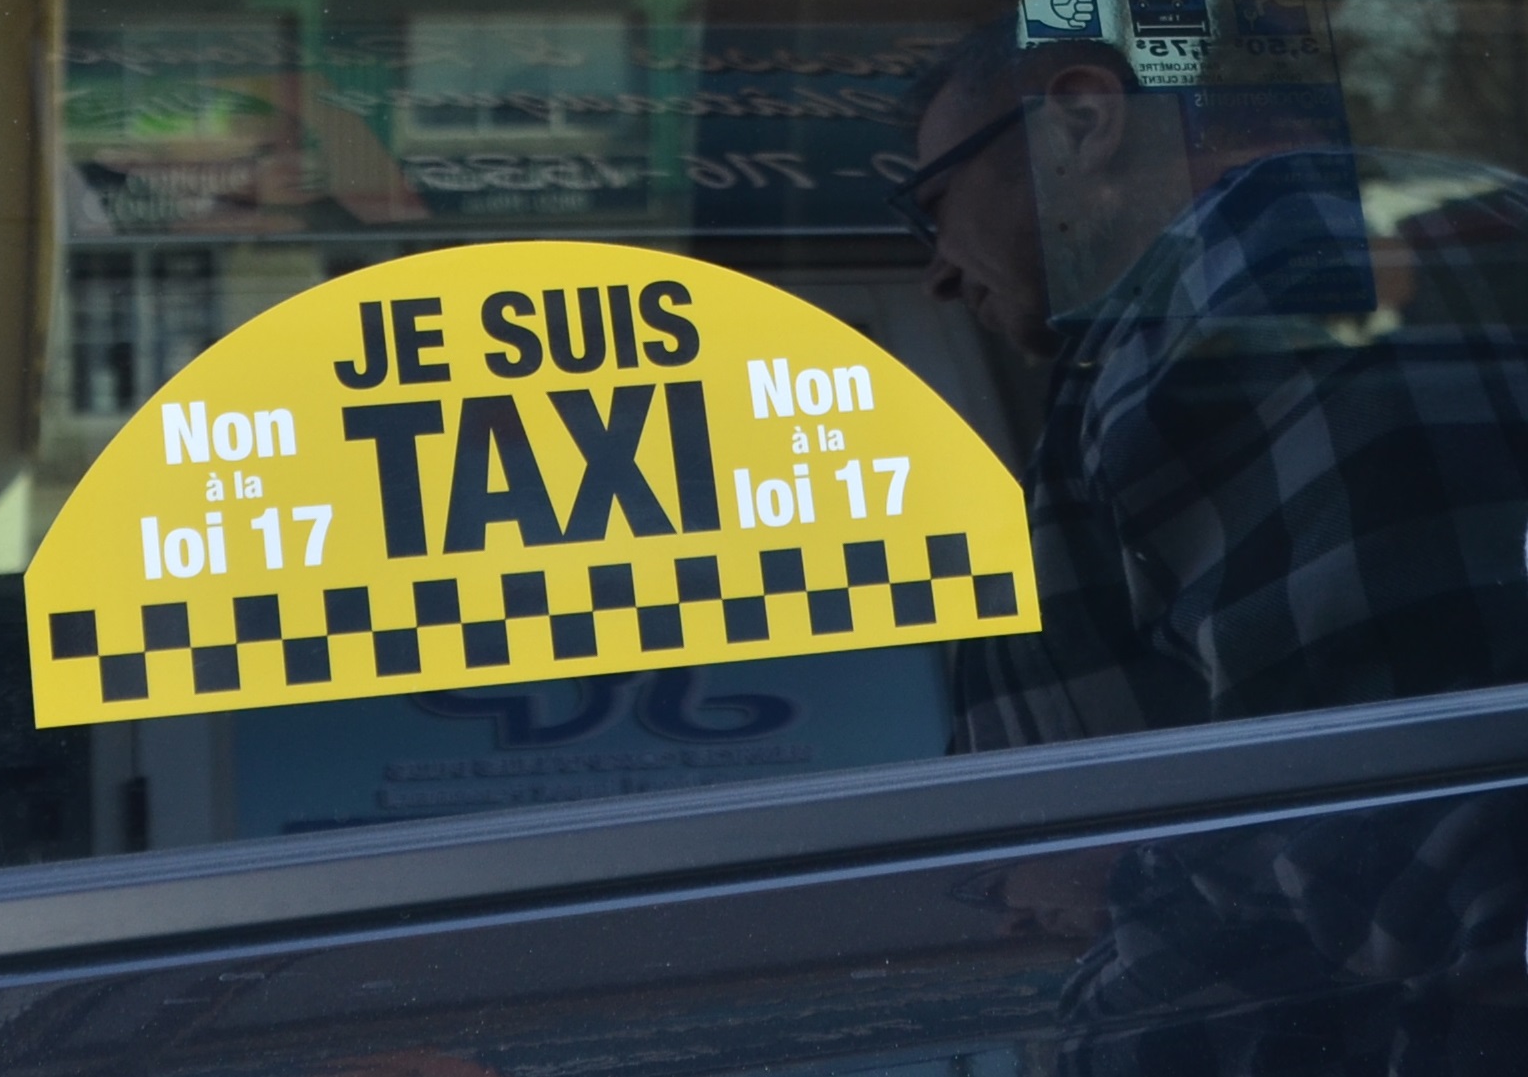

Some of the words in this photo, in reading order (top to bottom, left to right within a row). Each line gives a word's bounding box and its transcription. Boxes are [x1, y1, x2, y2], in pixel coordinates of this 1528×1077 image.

[333, 297, 451, 390] JE
[481, 280, 700, 379] SUIS
[746, 357, 876, 420] Non
[160, 400, 298, 466] Non
[791, 425, 811, 455] à
[816, 423, 846, 453] la
[205, 471, 226, 503] à
[233, 470, 264, 500] la
[341, 380, 722, 560] TAXI
[733, 462, 816, 530] loi
[834, 455, 911, 520] 17
[140, 510, 228, 581] loi
[250, 503, 334, 570] 17
